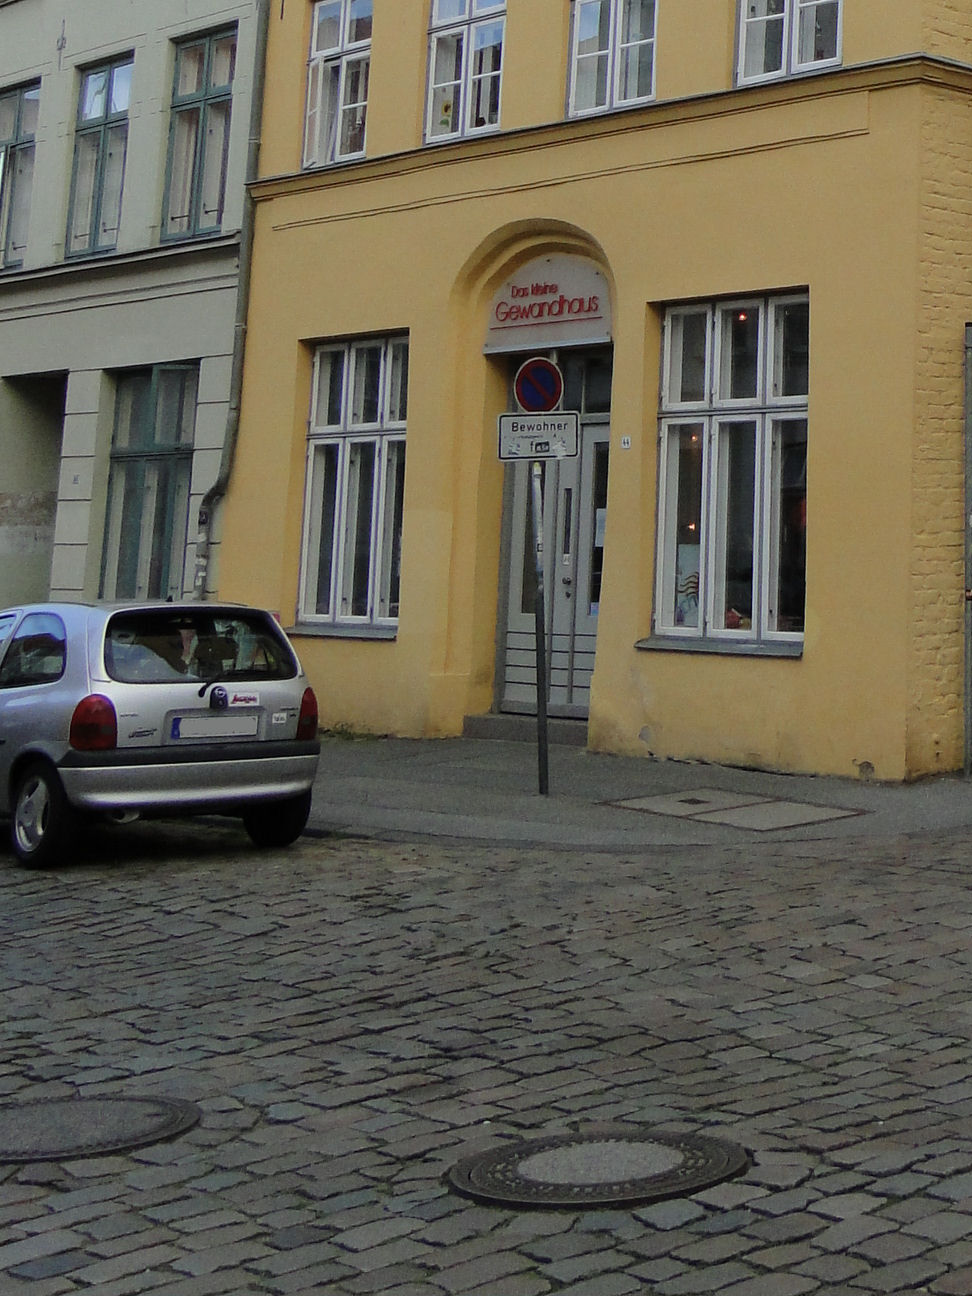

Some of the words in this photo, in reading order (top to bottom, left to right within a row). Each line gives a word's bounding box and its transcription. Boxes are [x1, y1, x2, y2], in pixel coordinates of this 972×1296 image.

[511, 286, 529, 298] Das
[531, 283, 558, 295] kleine
[496, 295, 599, 322] Gewandhaus
[512, 422, 568, 432] Bewohner
